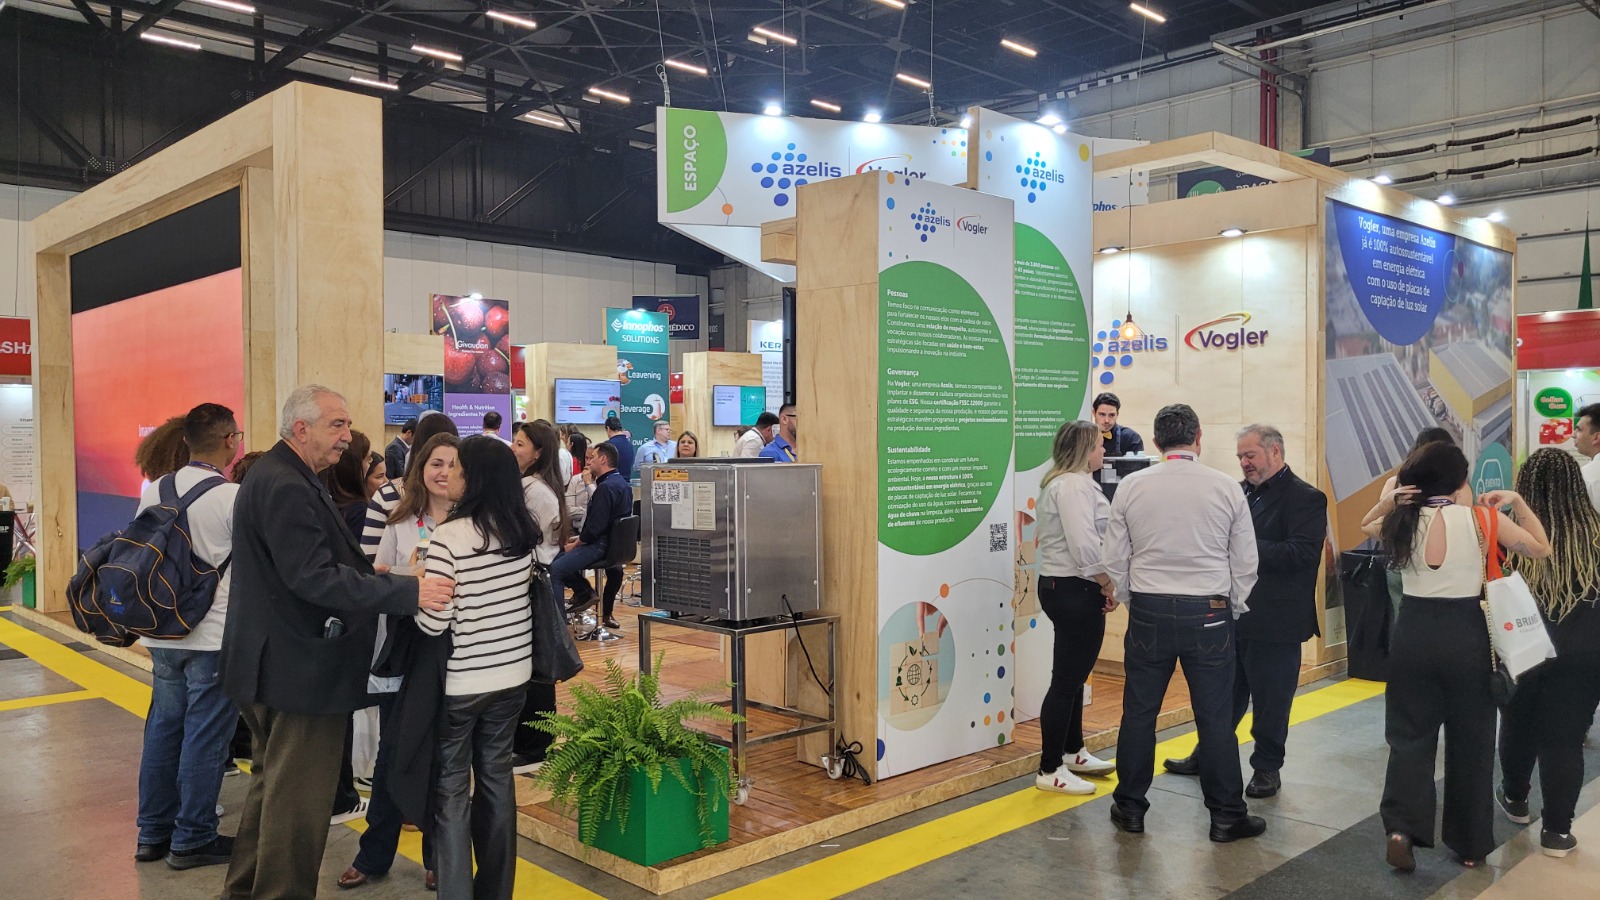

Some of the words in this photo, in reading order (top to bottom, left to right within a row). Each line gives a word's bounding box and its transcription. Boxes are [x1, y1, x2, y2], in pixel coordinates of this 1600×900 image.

[683, 125, 700, 191] ESPAÇO
[782, 162, 842, 178] azelis
[1032, 168, 1065, 184] azelis
[924, 215, 951, 227] azelis
[962, 220, 988, 235] Vogler
[1358, 216, 1380, 234] Vogler,
[1382, 225, 1395, 237] uma
[1396, 230, 1420, 244] empresa
[1420, 234, 1436, 248] Azelis
[1362, 236, 1368, 250] já
[1368, 238, 1372, 248] é
[1374, 238, 1388, 252] 100%
[1390, 245, 1434, 264] autossustentável
[1372, 259, 1382, 268] em
[1383, 260, 1405, 276] energia
[1406, 264, 1426, 278] elétrica
[887, 289, 908, 298] Pessoas
[1366, 276, 1380, 286] com
[1382, 279, 1386, 288] o
[1386, 280, 1397, 290] uso
[1398, 280, 1405, 292] de
[1406, 282, 1422, 294] placas
[1423, 284, 1430, 296] de
[1370, 294, 1396, 310] captação
[1397, 296, 1404, 308] de
[1405, 298, 1414, 310] luz
[1414, 300, 1428, 312] solar
[0, 341, 32, 354] SH
[457, 340, 488, 349] Givaudan
[622, 335, 659, 344] SOLUTIONS
[1108, 335, 1168, 352] azelis
[1198, 328, 1268, 350] Vogler
[627, 370, 661, 380] Leavening
[887, 368, 919, 377] Governança
[1485, 478, 1500, 488] EVENTO
